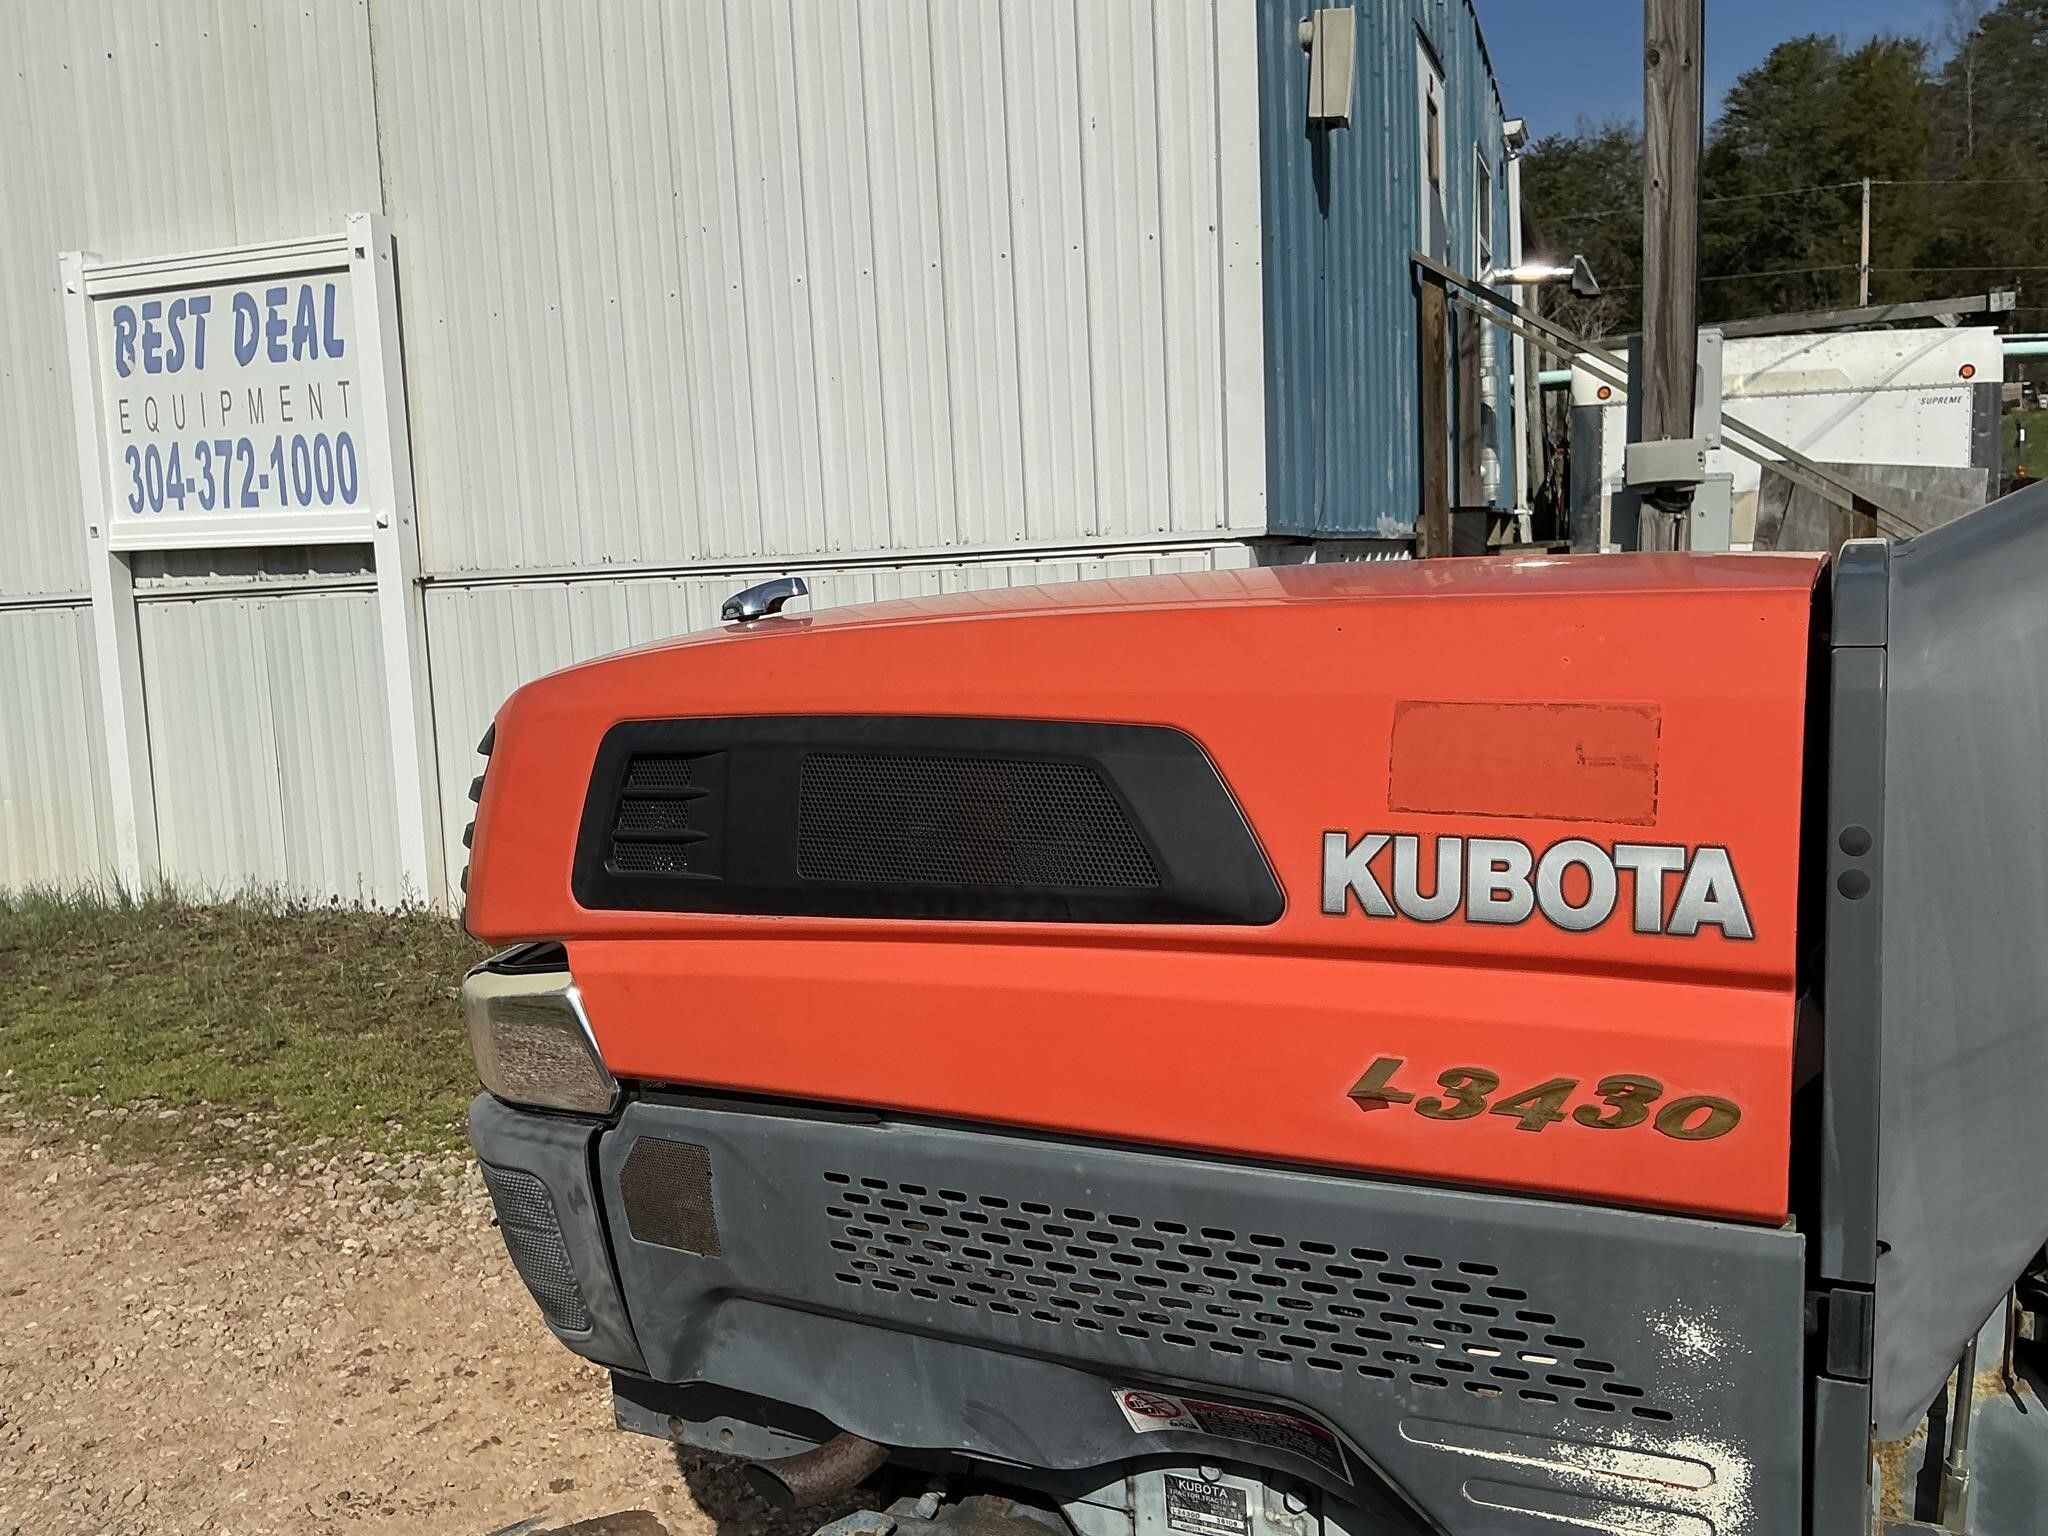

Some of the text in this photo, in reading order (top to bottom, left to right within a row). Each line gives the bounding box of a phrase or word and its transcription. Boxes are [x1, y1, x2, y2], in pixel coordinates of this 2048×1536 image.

[113, 283, 345, 378] BEST DEAL
[118, 380, 351, 434] EQUIPMENT
[1919, 395, 1964, 406] SUPREME
[124, 431, 359, 514] 304-372-1000
[1321, 830, 1756, 941] KUBOTA
[1346, 1057, 1742, 1141] L3430
[1178, 1479, 1229, 1499] KUBOTA
